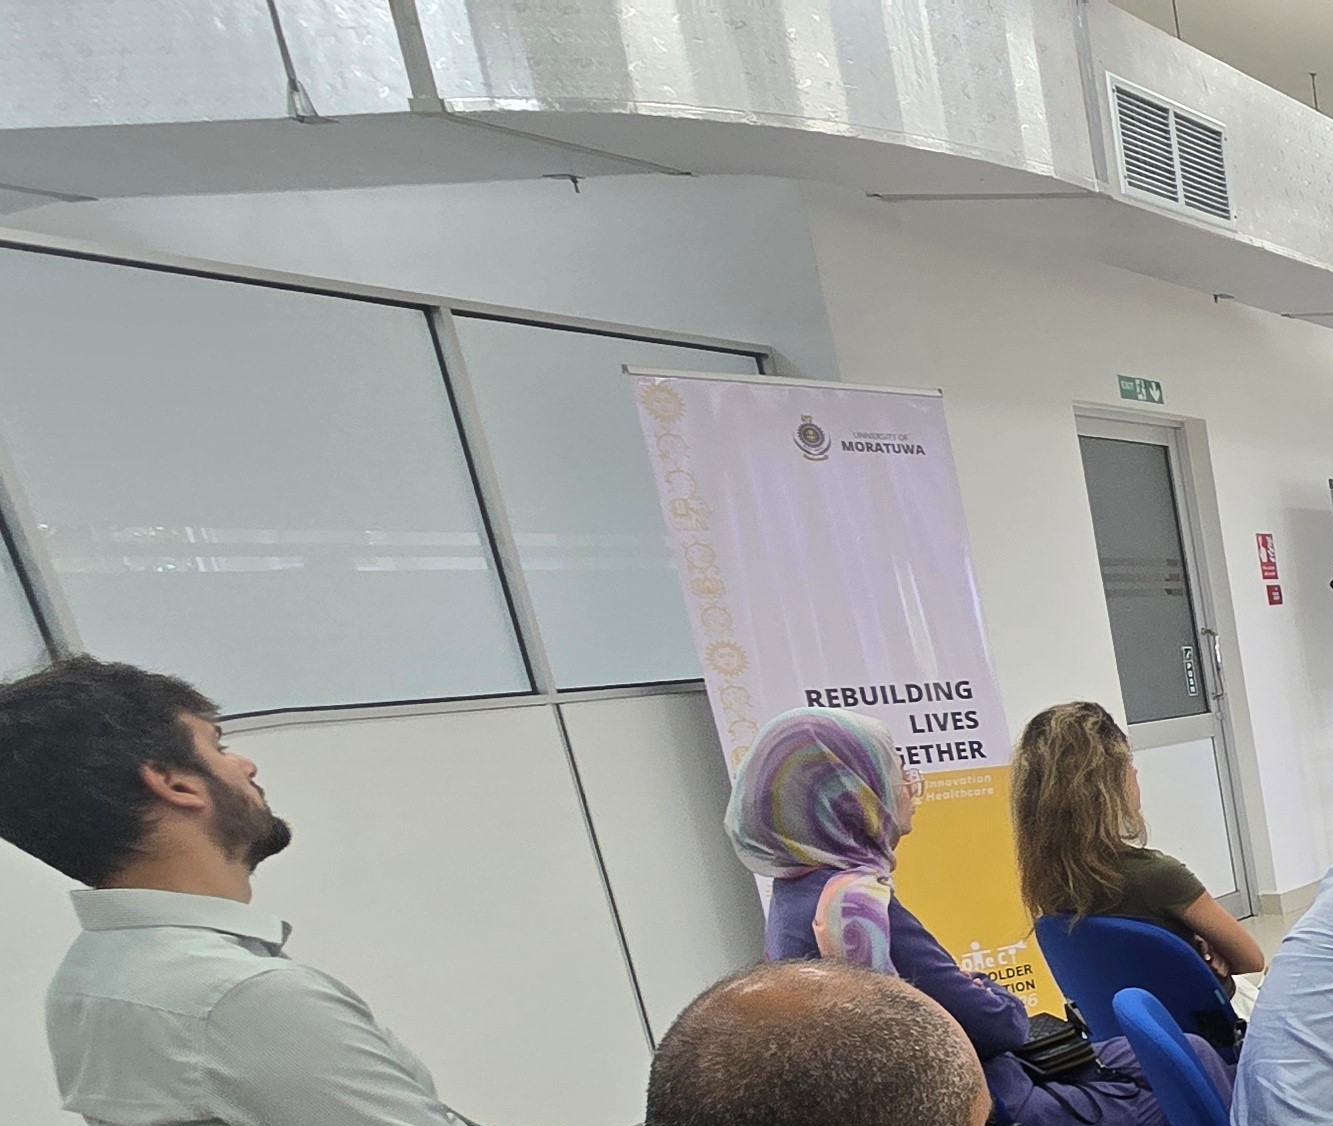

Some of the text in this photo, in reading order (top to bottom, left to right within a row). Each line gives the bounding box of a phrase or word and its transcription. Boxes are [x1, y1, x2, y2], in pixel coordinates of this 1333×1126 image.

[852, 431, 908, 441] UNIVERSITY OF
[841, 440, 926, 456] MORATUWA
[804, 680, 974, 709] REBUILDING
[909, 710, 980, 734] LIVES
[895, 740, 987, 766] GETHER
[926, 774, 992, 788] Innovation
[926, 786, 994, 802] Healthcare
[988, 963, 1033, 982] OLDER
[1003, 979, 1036, 993] TION
